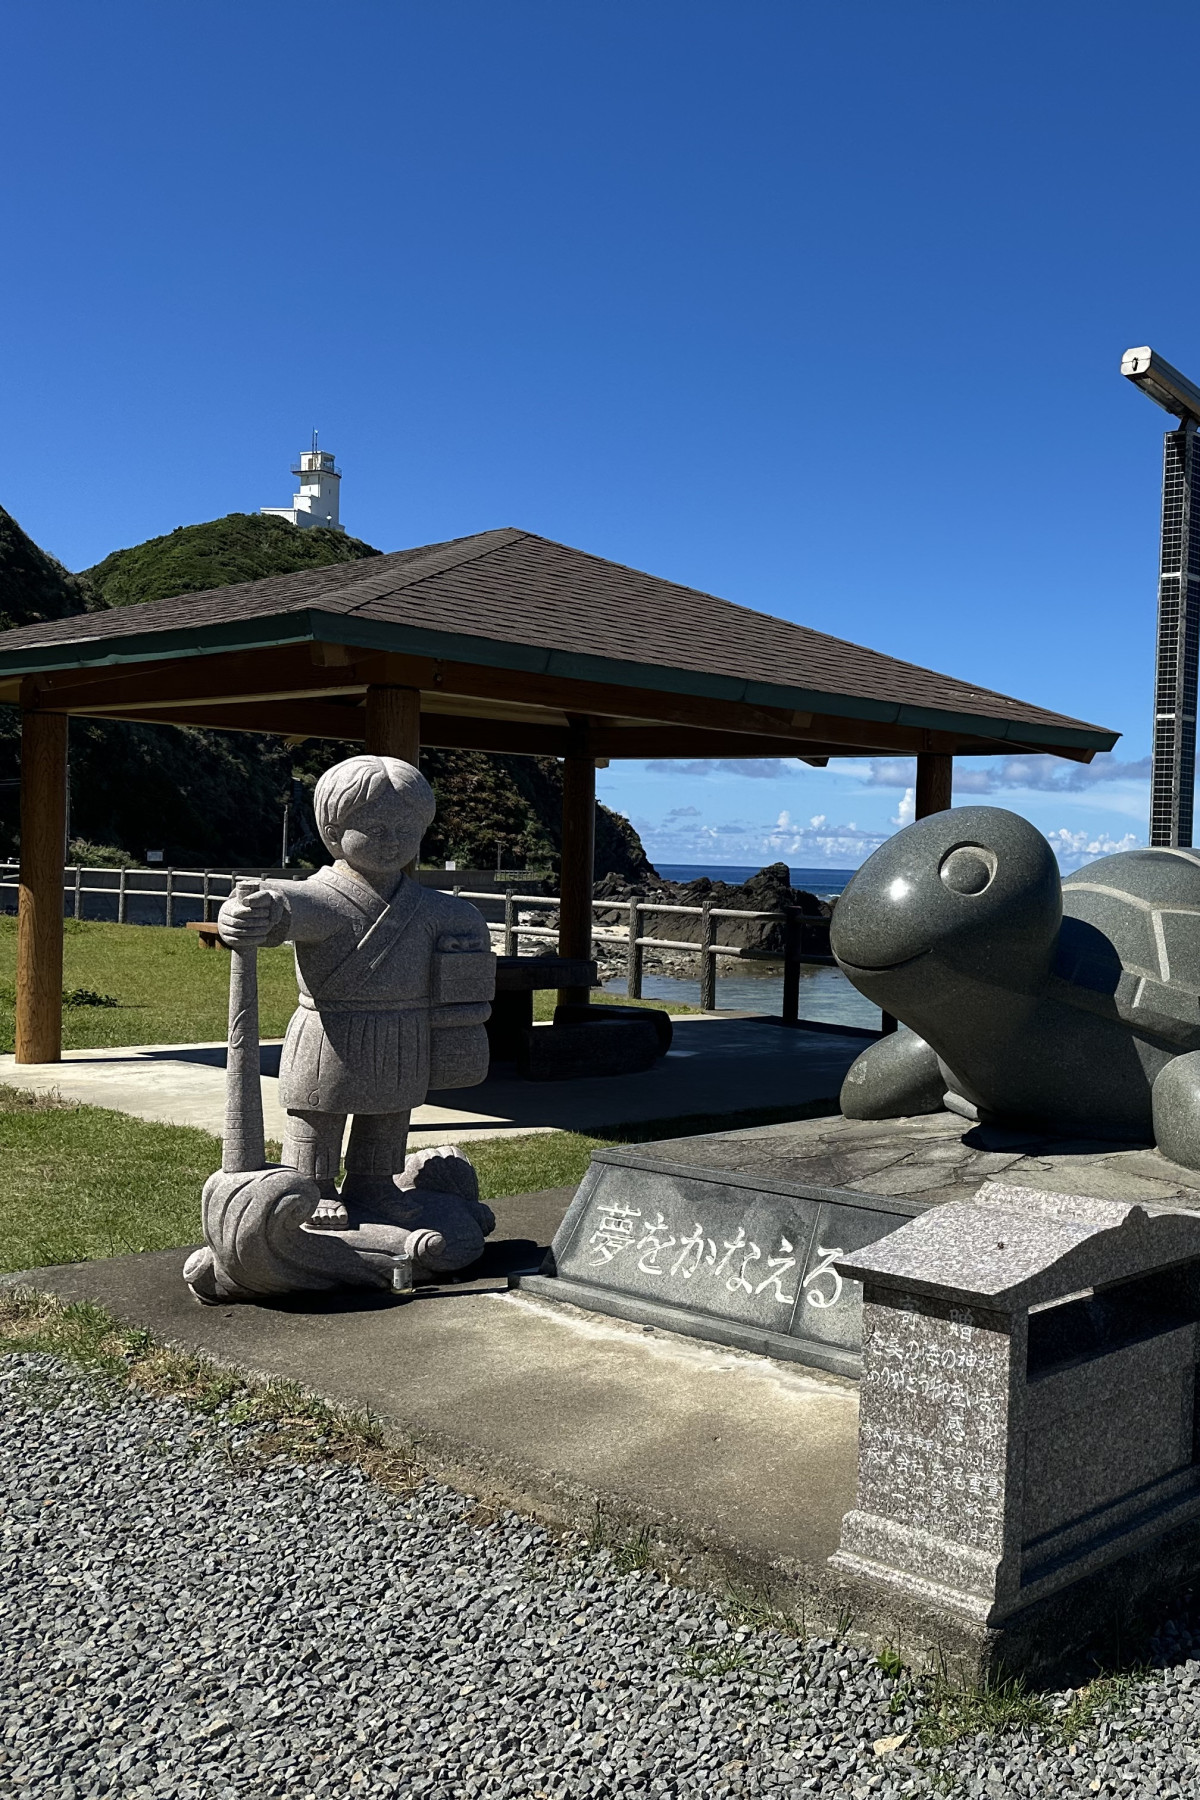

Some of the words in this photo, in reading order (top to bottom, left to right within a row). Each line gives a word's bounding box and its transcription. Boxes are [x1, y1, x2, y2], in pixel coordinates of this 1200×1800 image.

[589, 1202, 844, 1308] 夢をかなえる
